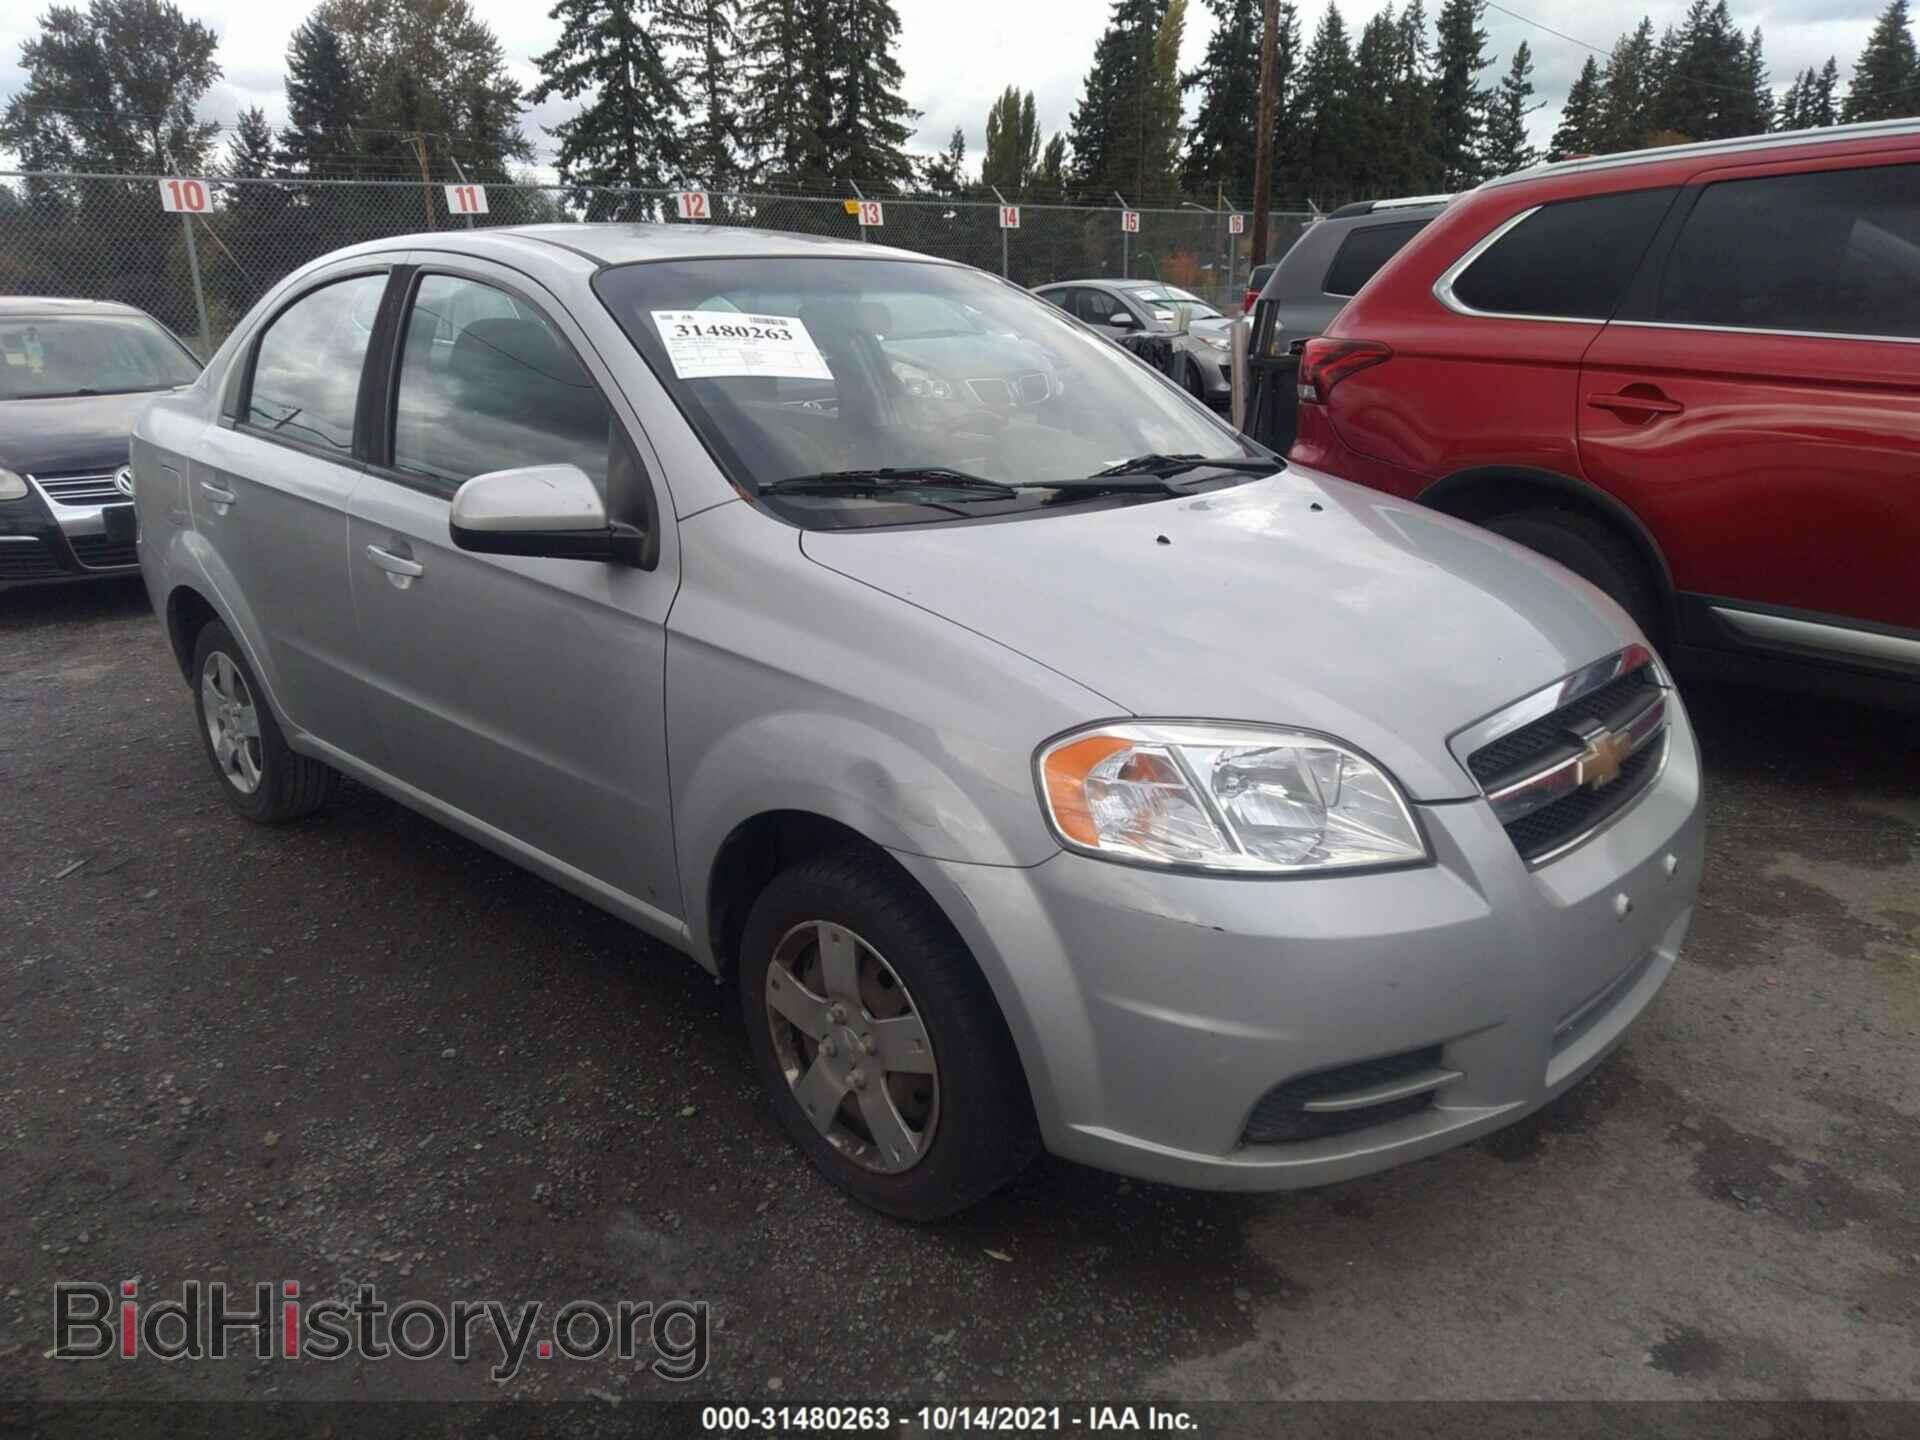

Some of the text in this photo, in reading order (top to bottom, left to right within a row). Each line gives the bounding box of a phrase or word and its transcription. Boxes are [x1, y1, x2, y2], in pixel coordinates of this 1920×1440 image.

[167, 181, 204, 210] 10
[454, 186, 478, 211] 11
[682, 193, 705, 216] 12
[861, 203, 879, 224] 13
[1002, 207, 1017, 225] 14
[1125, 213, 1137, 230] 15
[673, 323, 793, 341] 31480263
